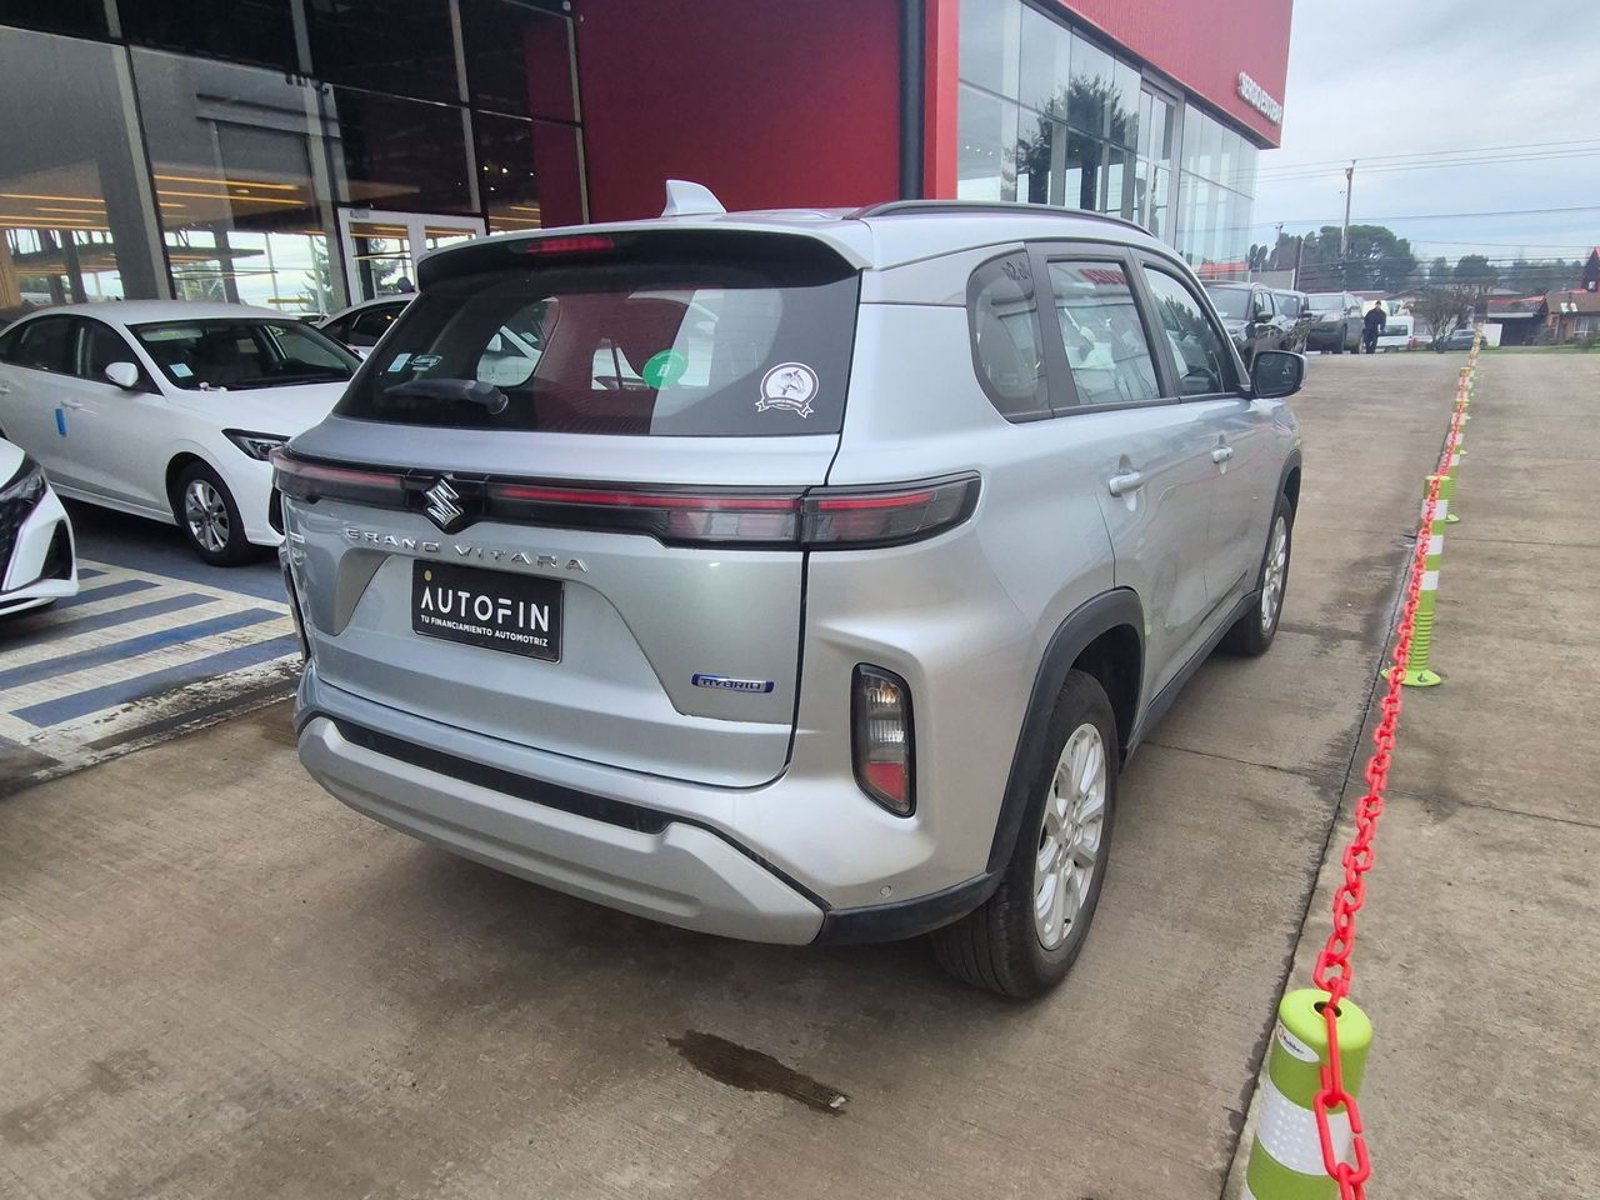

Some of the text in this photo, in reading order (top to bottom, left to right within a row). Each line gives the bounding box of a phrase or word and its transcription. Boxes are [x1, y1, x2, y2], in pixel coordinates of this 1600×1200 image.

[345, 528, 589, 573] GRAND VITARA
[420, 586, 549, 632] AUTOFIN
[421, 615, 549, 647] TU FINANCIAMIENTO AUTOMOTRIZ
[701, 678, 761, 690] HYBRID
